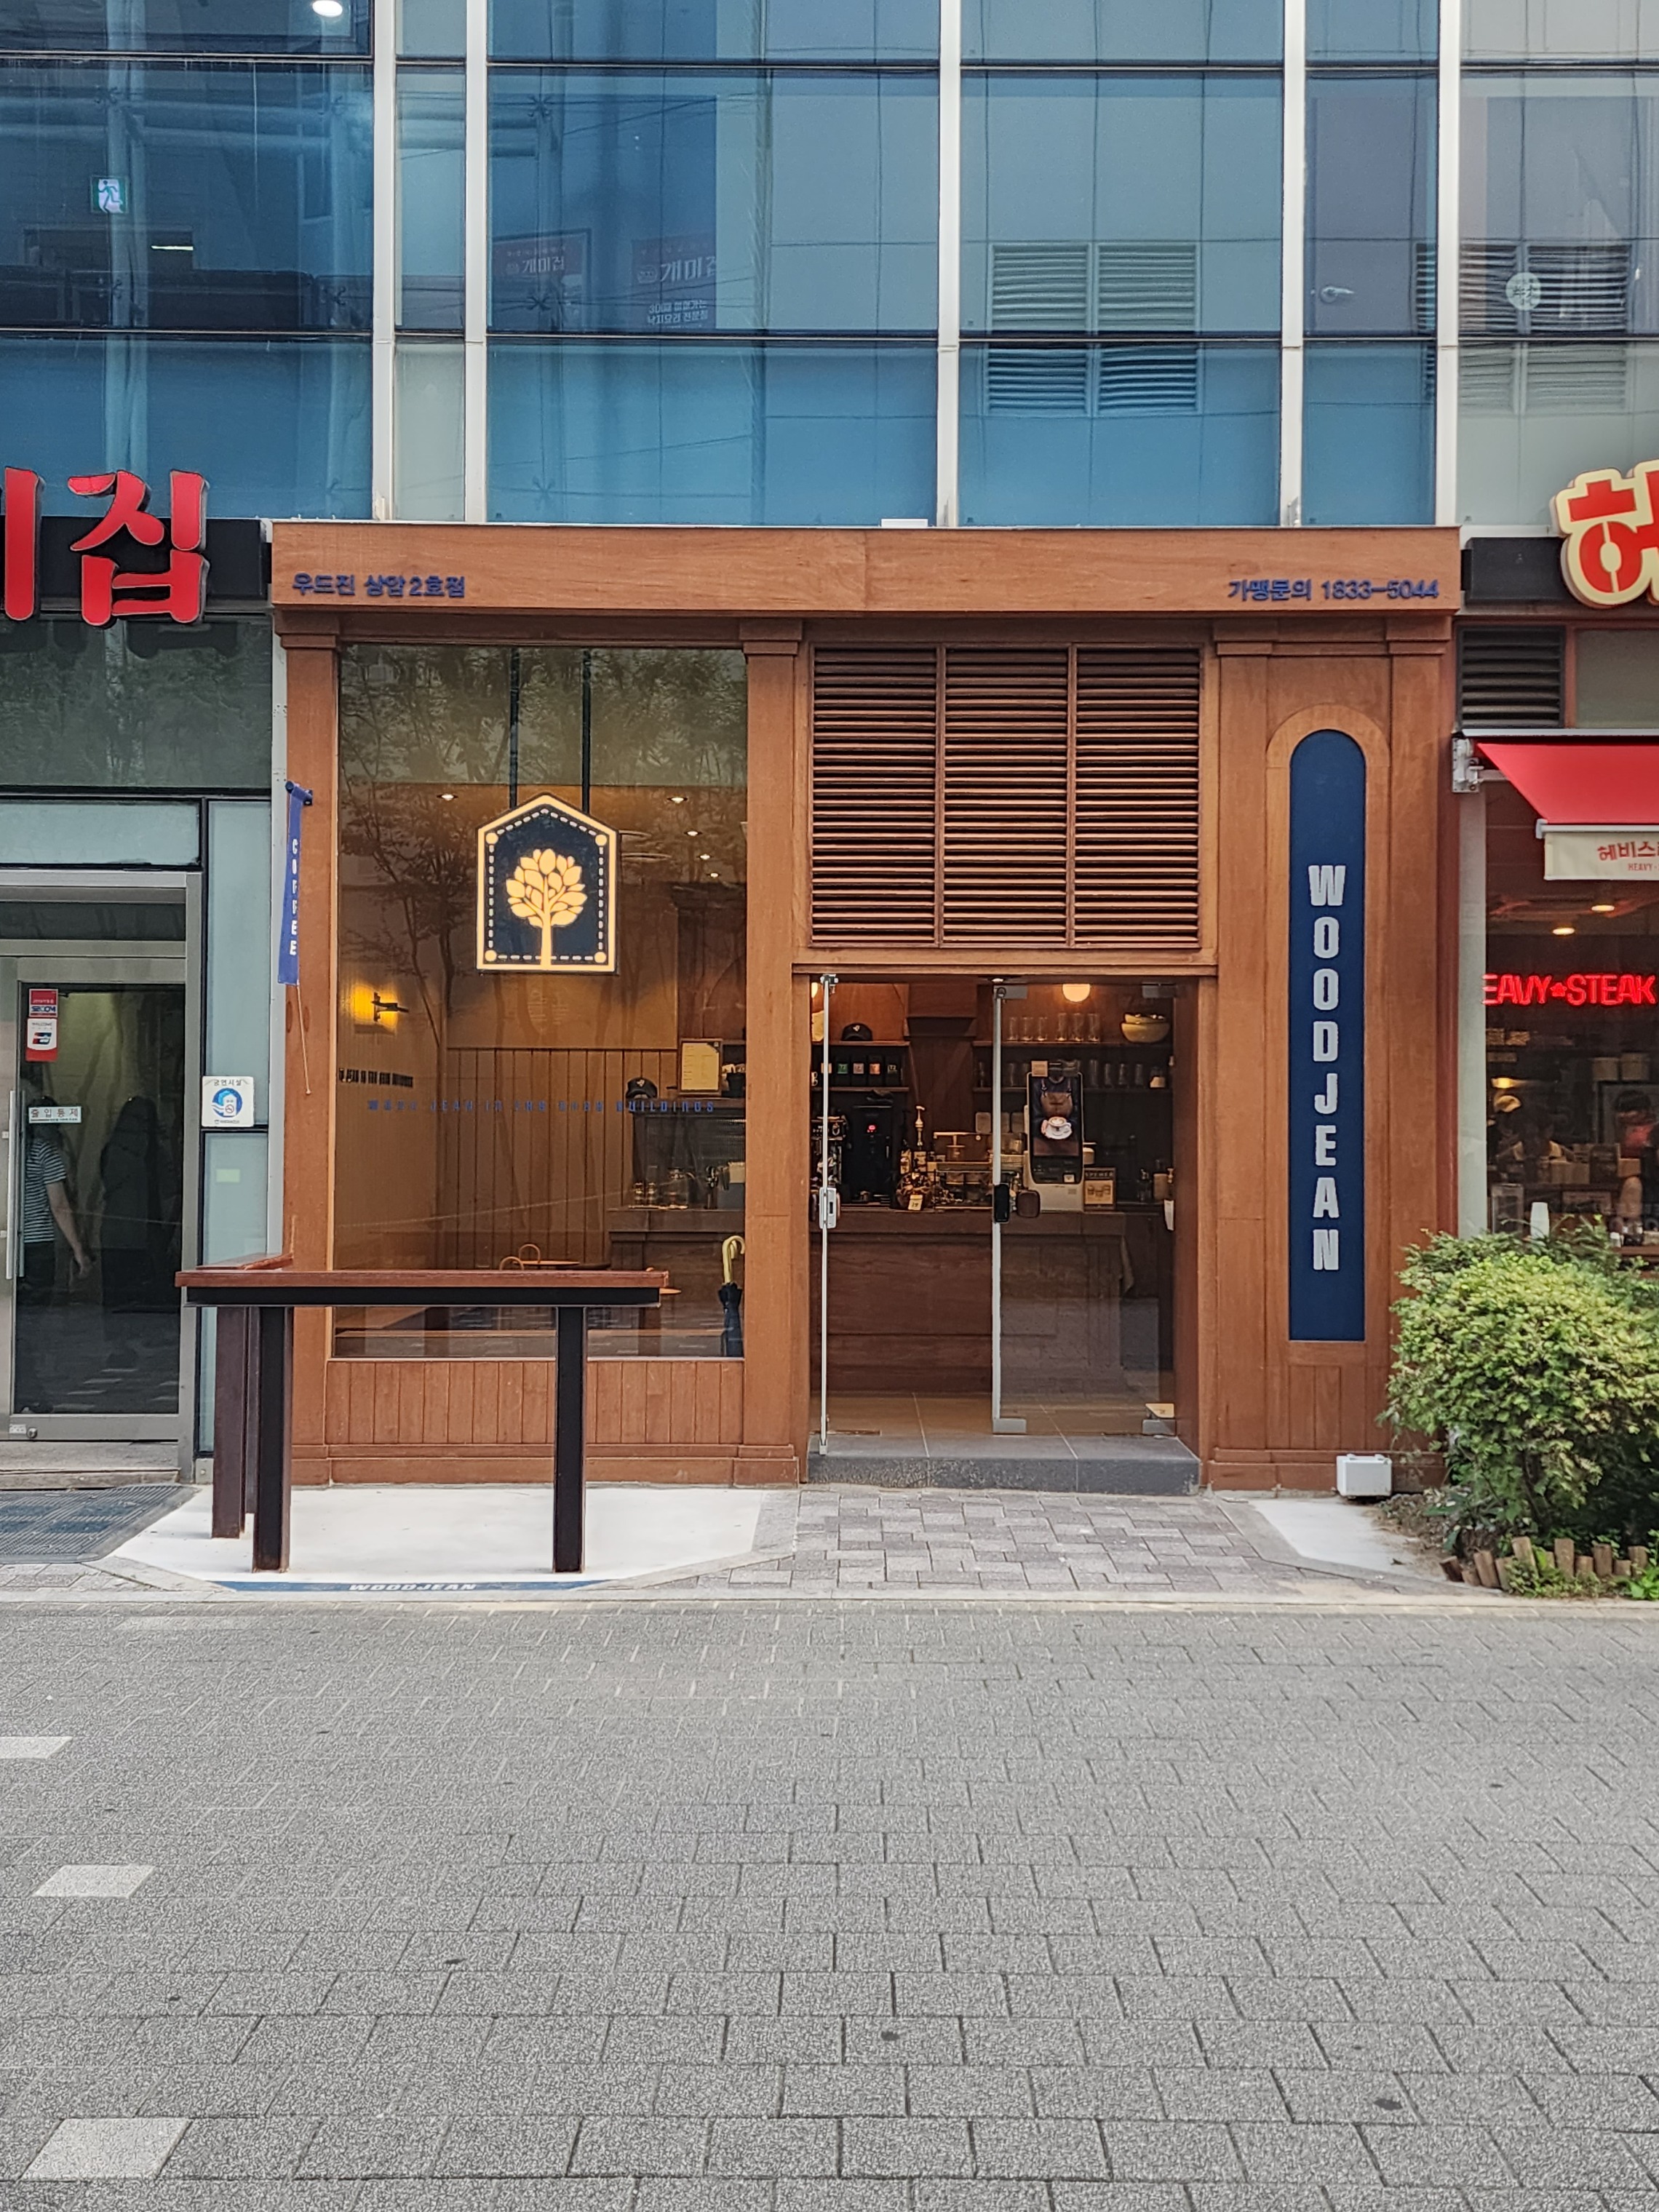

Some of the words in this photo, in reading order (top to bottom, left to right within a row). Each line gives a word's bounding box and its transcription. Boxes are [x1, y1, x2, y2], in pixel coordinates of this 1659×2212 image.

[293, 573, 355, 597] 우드진
[363, 574, 466, 597] 상암2호점
[1228, 578, 1312, 602] 가맹문의
[1321, 579, 1439, 600] 1833-5044
[1596, 841, 1659, 861] 헤비스
[1566, 973, 1658, 1006] STEAK
[1308, 864, 1346, 1271] WOODJEAN
[615, 1099, 714, 1113] BUILDINGS
[349, 1583, 477, 1591] WOODJEAN
